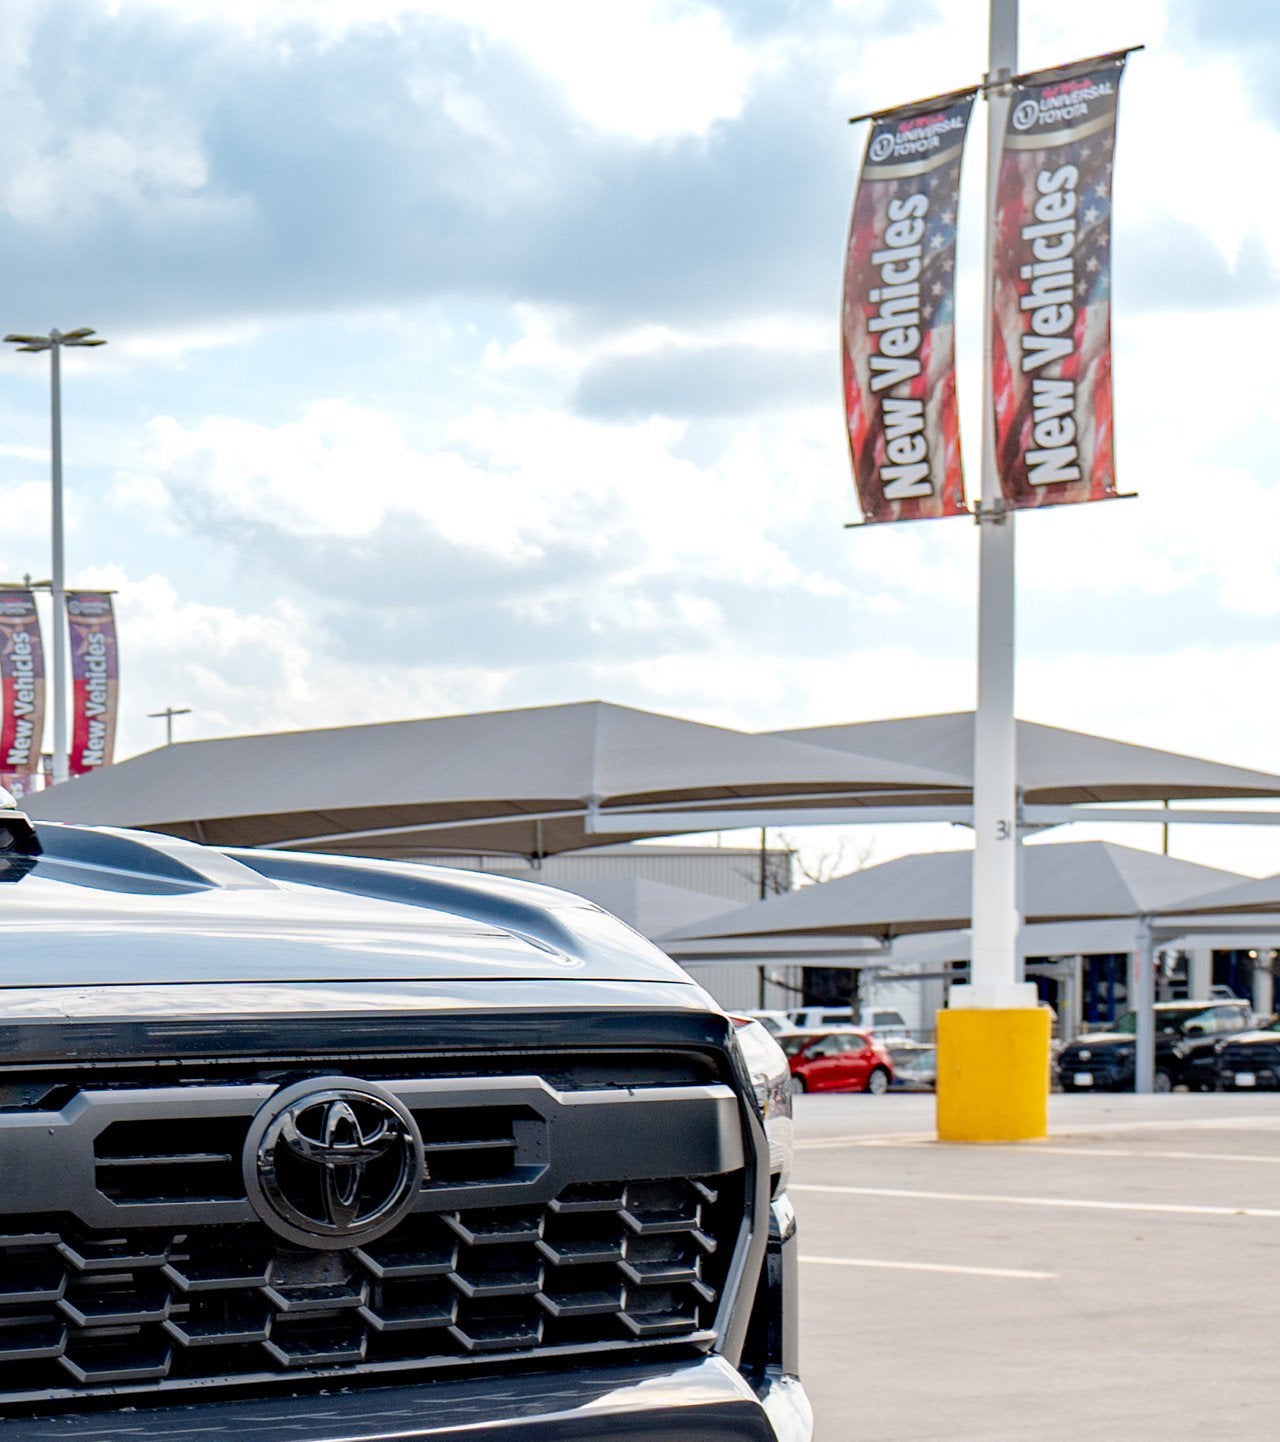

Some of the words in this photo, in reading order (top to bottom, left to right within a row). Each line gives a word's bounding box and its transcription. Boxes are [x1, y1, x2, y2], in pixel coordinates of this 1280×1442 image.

[895, 116, 965, 144] UNIVERSAL
[1038, 102, 1088, 126] TOYOTA
[1039, 82, 1114, 111] UNIVERSAL
[893, 135, 941, 158] TOYOTA
[867, 193, 930, 393] Vehicles
[1020, 163, 1080, 373] Vehicles
[879, 398, 933, 500] New
[1024, 378, 1082, 487] New
[10, 631, 35, 717] Vehicles
[84, 632, 108, 718] Vehicles
[6, 718, 34, 766] New
[81, 718, 106, 766] New
